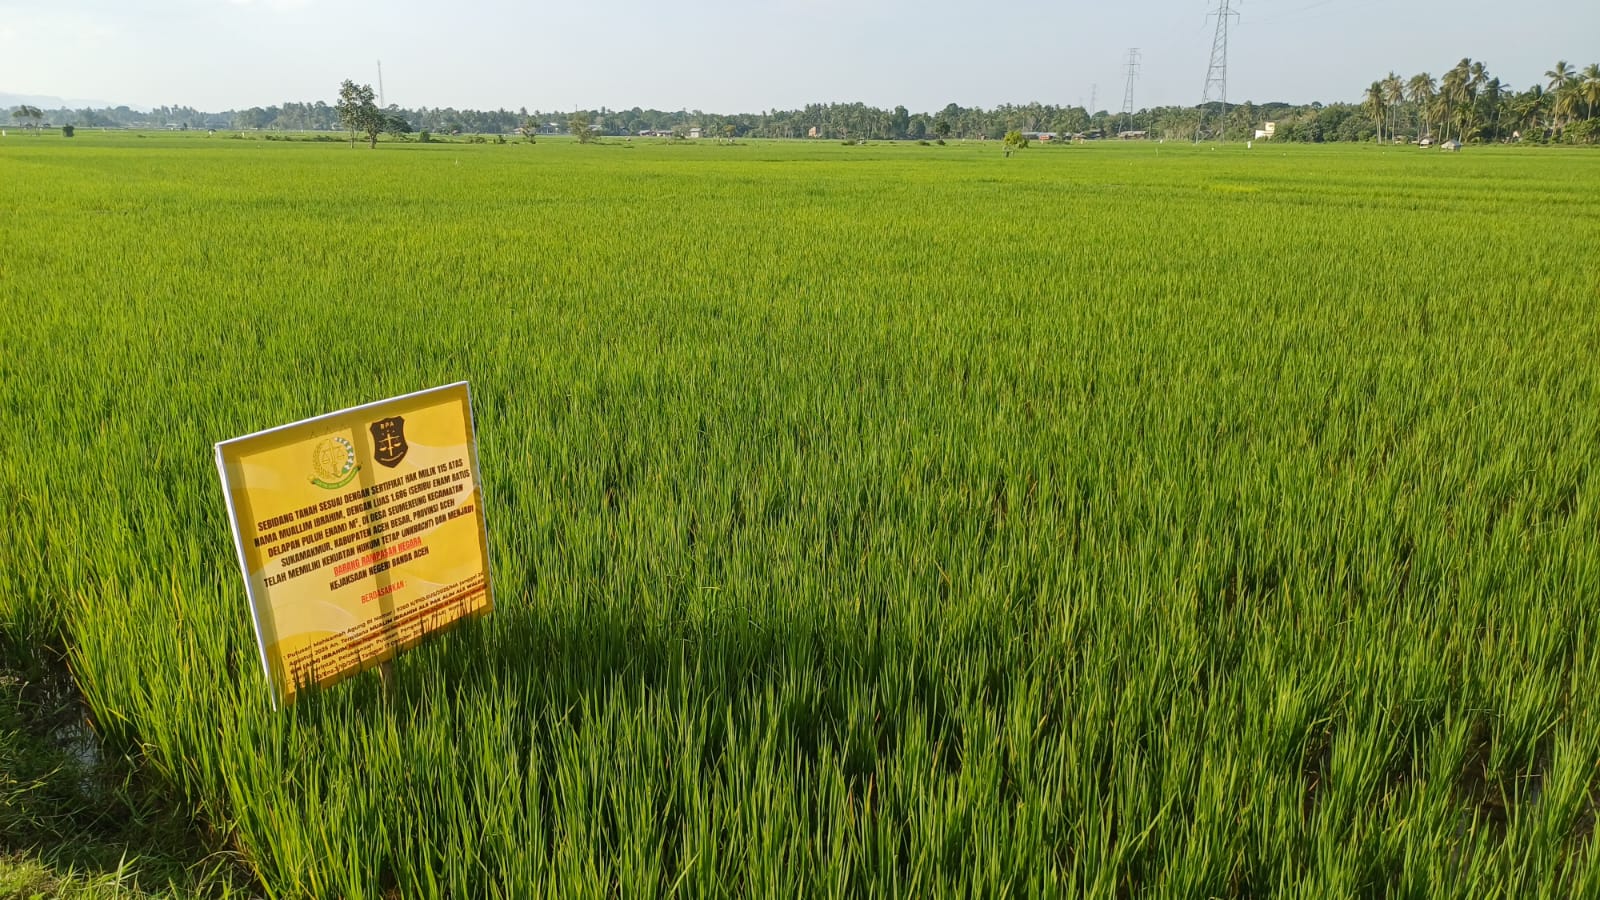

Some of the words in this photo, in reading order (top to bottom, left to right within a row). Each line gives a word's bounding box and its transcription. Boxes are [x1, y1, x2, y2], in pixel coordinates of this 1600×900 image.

[254, 532, 277, 547] NAMA
[278, 521, 312, 539] MUALLIM
[313, 510, 345, 527] IBRAHIM,
[346, 501, 371, 516] DENGAN
[373, 495, 388, 507] LUAS
[408, 481, 430, 495] (SERIBU
[432, 475, 450, 487] ENAM
[451, 469, 469, 481] RATUS
[257, 512, 293, 531] SEBIDANG
[295, 505, 317, 519] TANAH
[319, 497, 342, 511] SESUAI
[344, 488, 369, 503] DENGAN
[371, 477, 403, 494] SERTIFIKAT
[405, 473, 417, 482] HAK
[418, 467, 435, 478] MILIK
[437, 464, 446, 472] 115
[448, 459, 462, 469] ATAS
[267, 538, 300, 557] DELAPAN
[301, 530, 323, 545] PULUH
[324, 523, 346, 537] ENAM)
[362, 515, 369, 524] DI
[370, 509, 386, 522] DESA
[388, 496, 426, 515] SEUMEREUNG
[427, 483, 462, 501] KECAMATAN
[264, 572, 286, 587] TELAH
[288, 560, 320, 579] MEMILIKI
[322, 547, 354, 566] KEKUATAN
[356, 538, 380, 553] HUKUM
[382, 531, 399, 544] TETAP
[435, 514, 446, 524] DAN
[448, 505, 473, 520] MENJADI
[281, 542, 332, 567] SUKAMAKMUR,
[334, 528, 371, 548] KABUPATEN
[373, 522, 389, 534] ACEH
[391, 514, 411, 528] BESAR,
[413, 504, 438, 520] PROVINSI
[440, 499, 454, 510] ACEH
[329, 569, 367, 590] KEJAKSAAN
[368, 561, 390, 575] NEGERI
[392, 553, 412, 566] BANDA
[413, 546, 428, 558] ACEH
[333, 559, 359, 576] BARANG
[361, 545, 396, 566] RAMPASAN
[398, 536, 421, 552] NEGARA
[361, 580, 403, 603] BERDASARKAN
